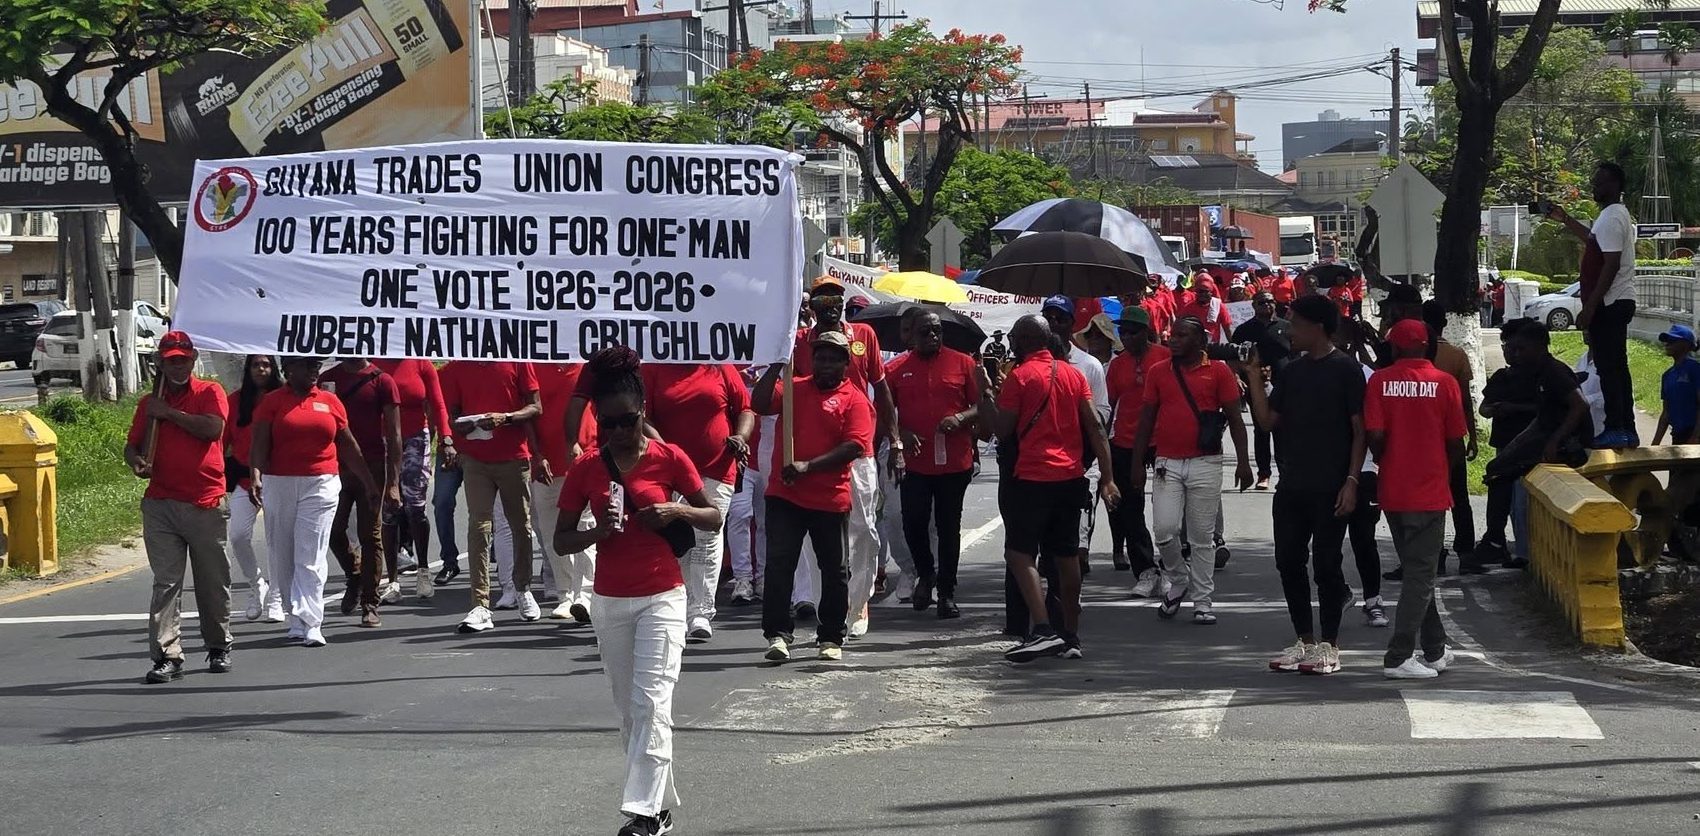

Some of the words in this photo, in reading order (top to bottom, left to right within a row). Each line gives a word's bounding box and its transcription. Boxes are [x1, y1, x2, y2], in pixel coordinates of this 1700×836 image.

[393, 16, 424, 45] 50
[403, 34, 429, 54] SMALL
[242, 70, 310, 134] Ezee
[301, 16, 384, 83] Pull
[263, 60, 296, 92] perforation
[313, 64, 383, 111] dispensing
[195, 82, 237, 112] RHINO
[294, 99, 347, 135] Garbage
[347, 80, 380, 104] Bags
[1015, 103, 1063, 115] TOWER
[262, 158, 357, 198] GUYANA
[373, 153, 482, 195] TRADES
[513, 152, 603, 193] UNION
[625, 155, 781, 196] CONGRESS
[254, 216, 297, 255] 100
[309, 215, 395, 255] YEARS
[403, 215, 538, 256] FIGHTING
[549, 215, 609, 256] FOR
[617, 217, 678, 258] ONE
[688, 218, 751, 260] MAN
[360, 268, 419, 309] ONE
[432, 269, 511, 311] VOTE
[526, 270, 696, 313] 1926-2026
[828, 266, 865, 288] GUYANA
[966, 289, 1009, 305] OFFICERS
[1013, 294, 1042, 305] UNION
[276, 314, 395, 356] HUBERT
[404, 317, 569, 361] NATHANIEL
[578, 319, 756, 361] CRITCHLOW
[1382, 380, 1418, 398] LABOUR
[1419, 381, 1439, 398] DAY
